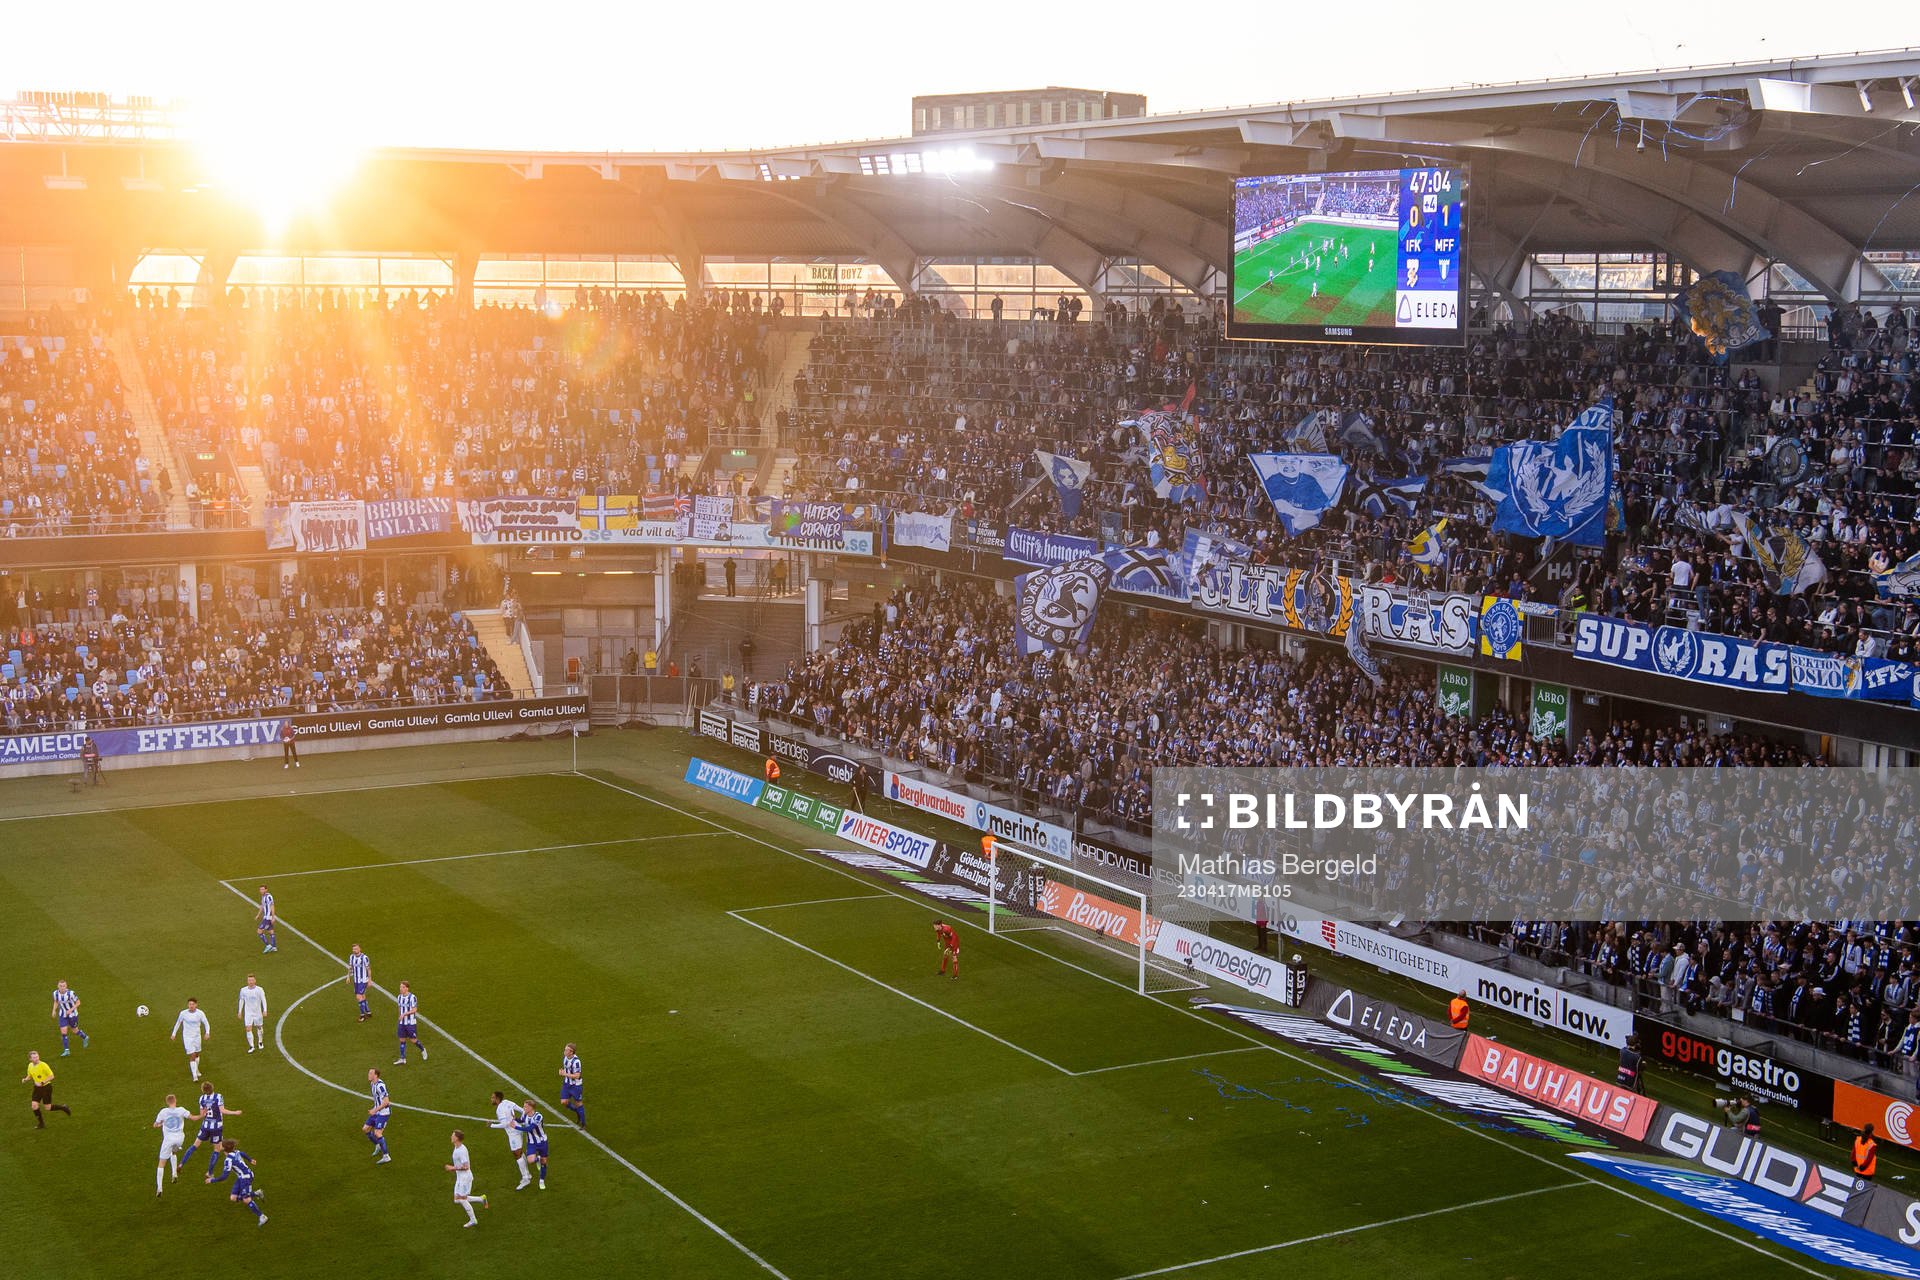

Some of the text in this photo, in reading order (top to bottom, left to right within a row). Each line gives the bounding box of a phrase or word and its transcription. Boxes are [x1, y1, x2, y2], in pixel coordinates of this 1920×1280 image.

[1410, 171, 1451, 193] 47:04
[1410, 205, 1449, 227] 0 1
[1406, 238, 1455, 252] IFK MFF
[812, 268, 862, 279] BACKA BOYZ
[1417, 302, 1457, 319] ELEDA
[1325, 328, 1352, 336] SAMSUNG
[366, 497, 450, 521] BEBBENS
[803, 504, 841, 520] HATERS
[622, 528, 643, 537] Vad
[646, 527, 662, 537] vill
[800, 523, 841, 538] CORNER
[1547, 562, 1572, 580] H4
[1578, 619, 1788, 684] SUP RAS
[1792, 655, 1840, 669] SEKTION
[1443, 671, 1467, 686] ÅBRO
[1793, 666, 1841, 687] OSLO
[1864, 663, 1912, 688] IFK
[1538, 690, 1565, 705] ÅBRO
[445, 710, 512, 724] Gamla Ullevi
[519, 704, 585, 718] Gamla Ullevi
[292, 719, 361, 735] Gamla Ullevi
[368, 715, 438, 729] Gamla Ullevi
[137, 720, 280, 752] EFFEKTIV
[769, 733, 808, 762] Helanders
[696, 763, 753, 795] EFFEKTIV
[766, 789, 782, 803] MCR
[900, 784, 965, 819] Bergkvarabuss
[793, 798, 809, 813] MCR
[819, 808, 836, 823] MCR
[852, 818, 929, 861] INTERSPORT
[1066, 892, 1127, 936] Renova
[1338, 930, 1449, 979] STENFASTIGHETER
[1478, 978, 1611, 1040] morris law.
[1361, 1006, 1426, 1049] ELEDA
[1482, 1047, 1630, 1123] BAUHAUS
[1731, 1076, 1798, 1108] Storköksutrustning
